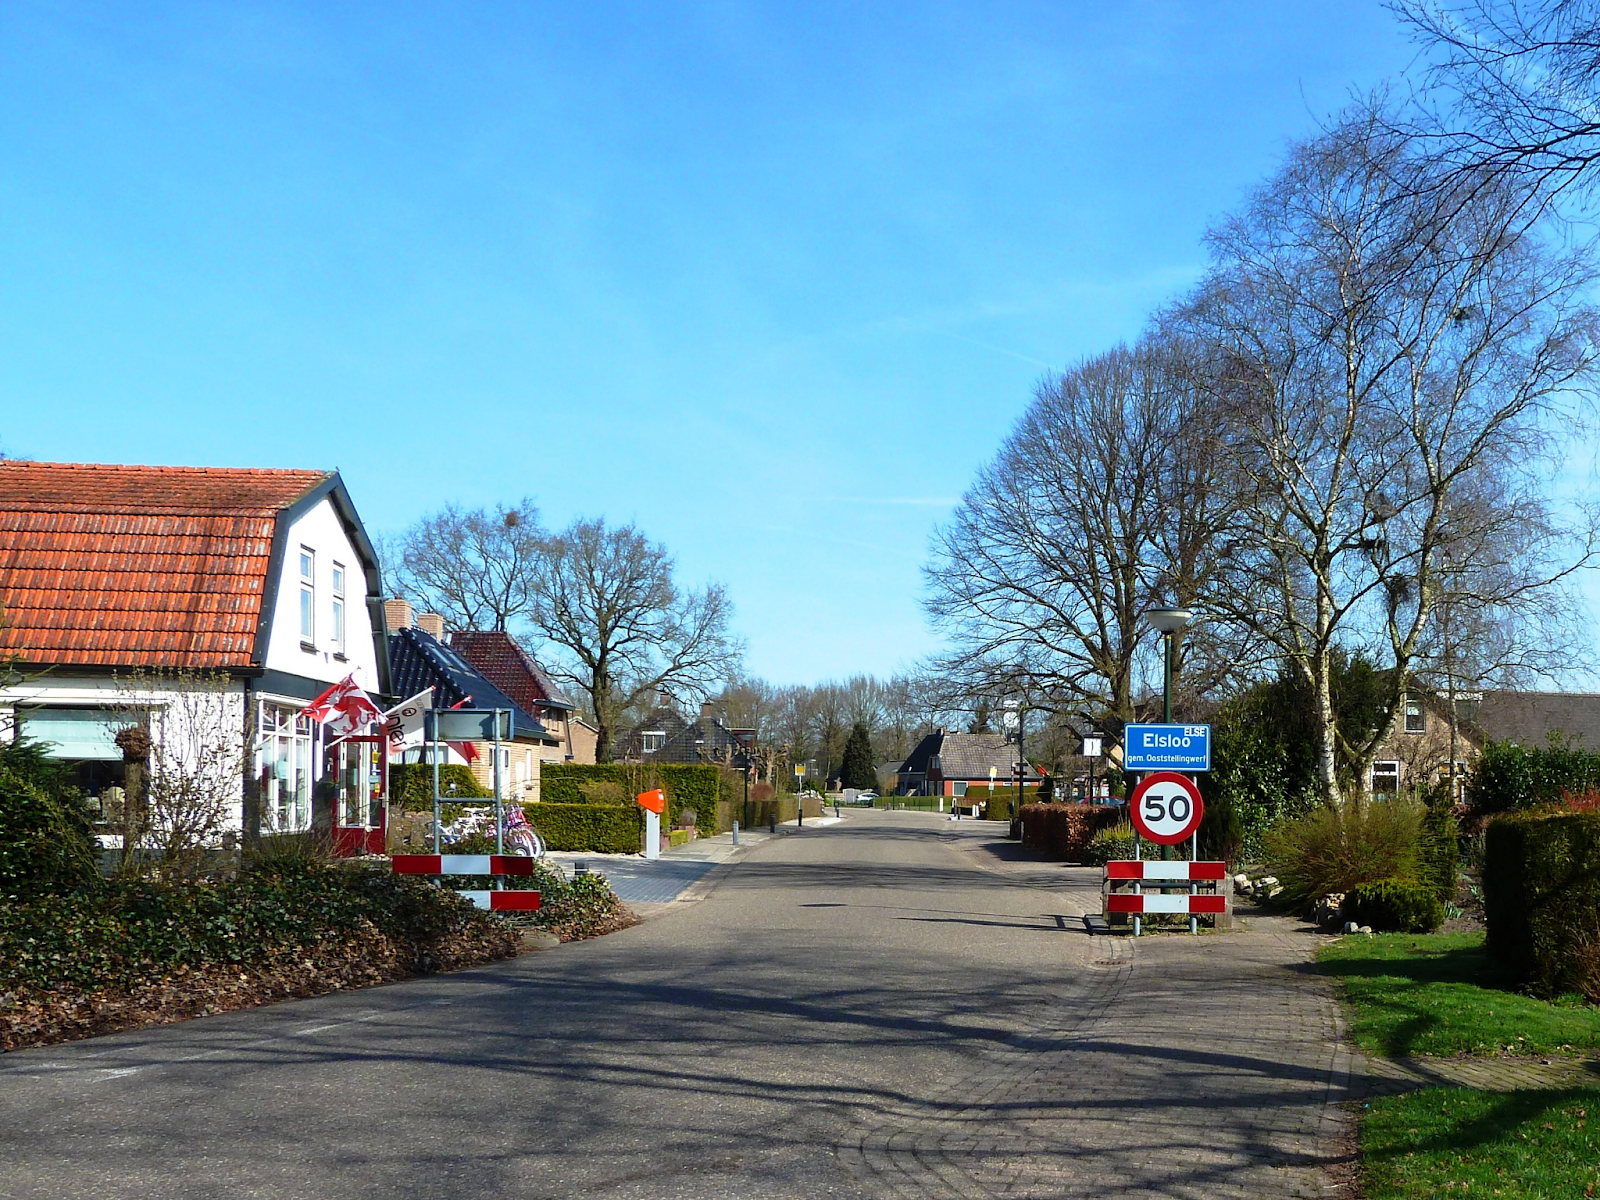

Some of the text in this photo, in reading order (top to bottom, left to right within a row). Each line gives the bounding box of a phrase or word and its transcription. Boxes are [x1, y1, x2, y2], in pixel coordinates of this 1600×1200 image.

[1184, 727, 1205, 737] ELSE
[1143, 733, 1191, 748] Elsloo
[1146, 754, 1206, 764] Ooststellingwerf
[1144, 795, 1190, 822] 50
